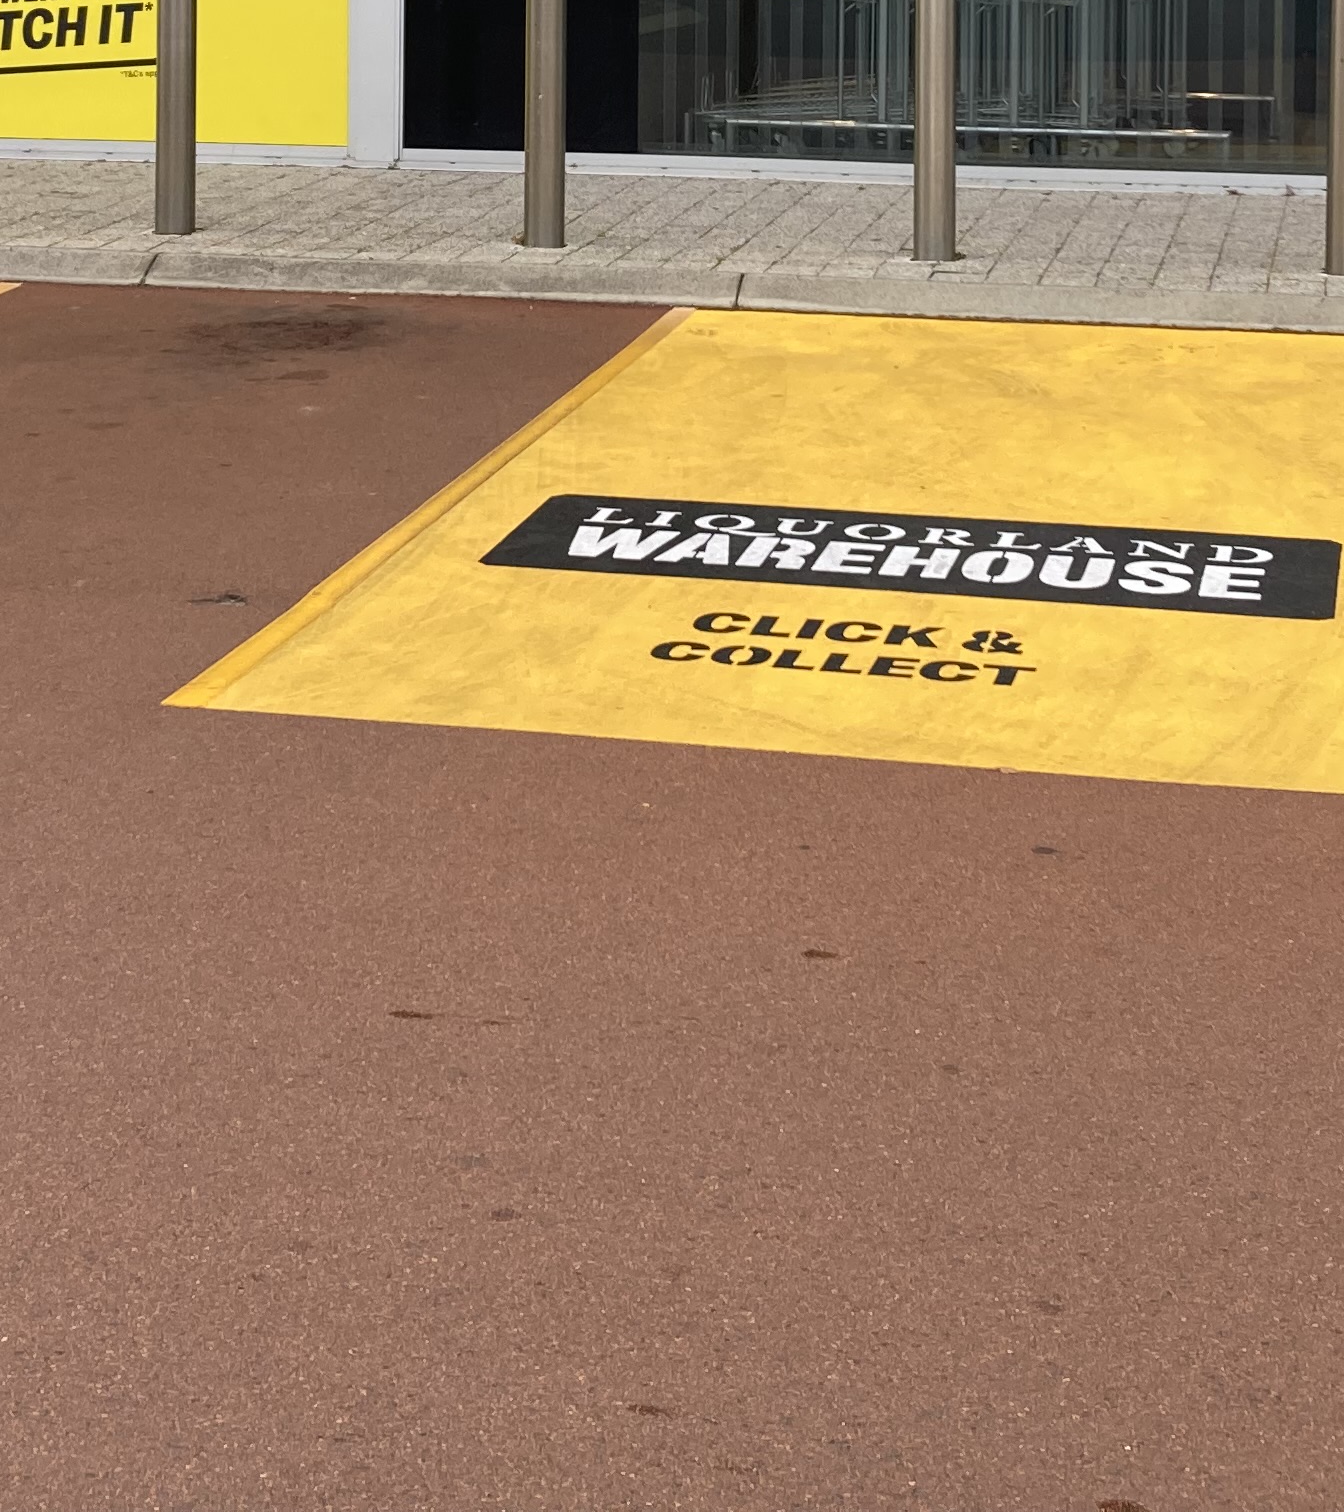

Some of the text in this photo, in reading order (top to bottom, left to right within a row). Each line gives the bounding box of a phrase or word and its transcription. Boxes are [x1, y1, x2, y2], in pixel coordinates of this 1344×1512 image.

[582, 506, 1274, 564] LIQUORLAND
[567, 524, 1266, 601] WAREHOUSE
[692, 612, 1024, 655] CLICK &
[650, 641, 1037, 687] COLLECT
